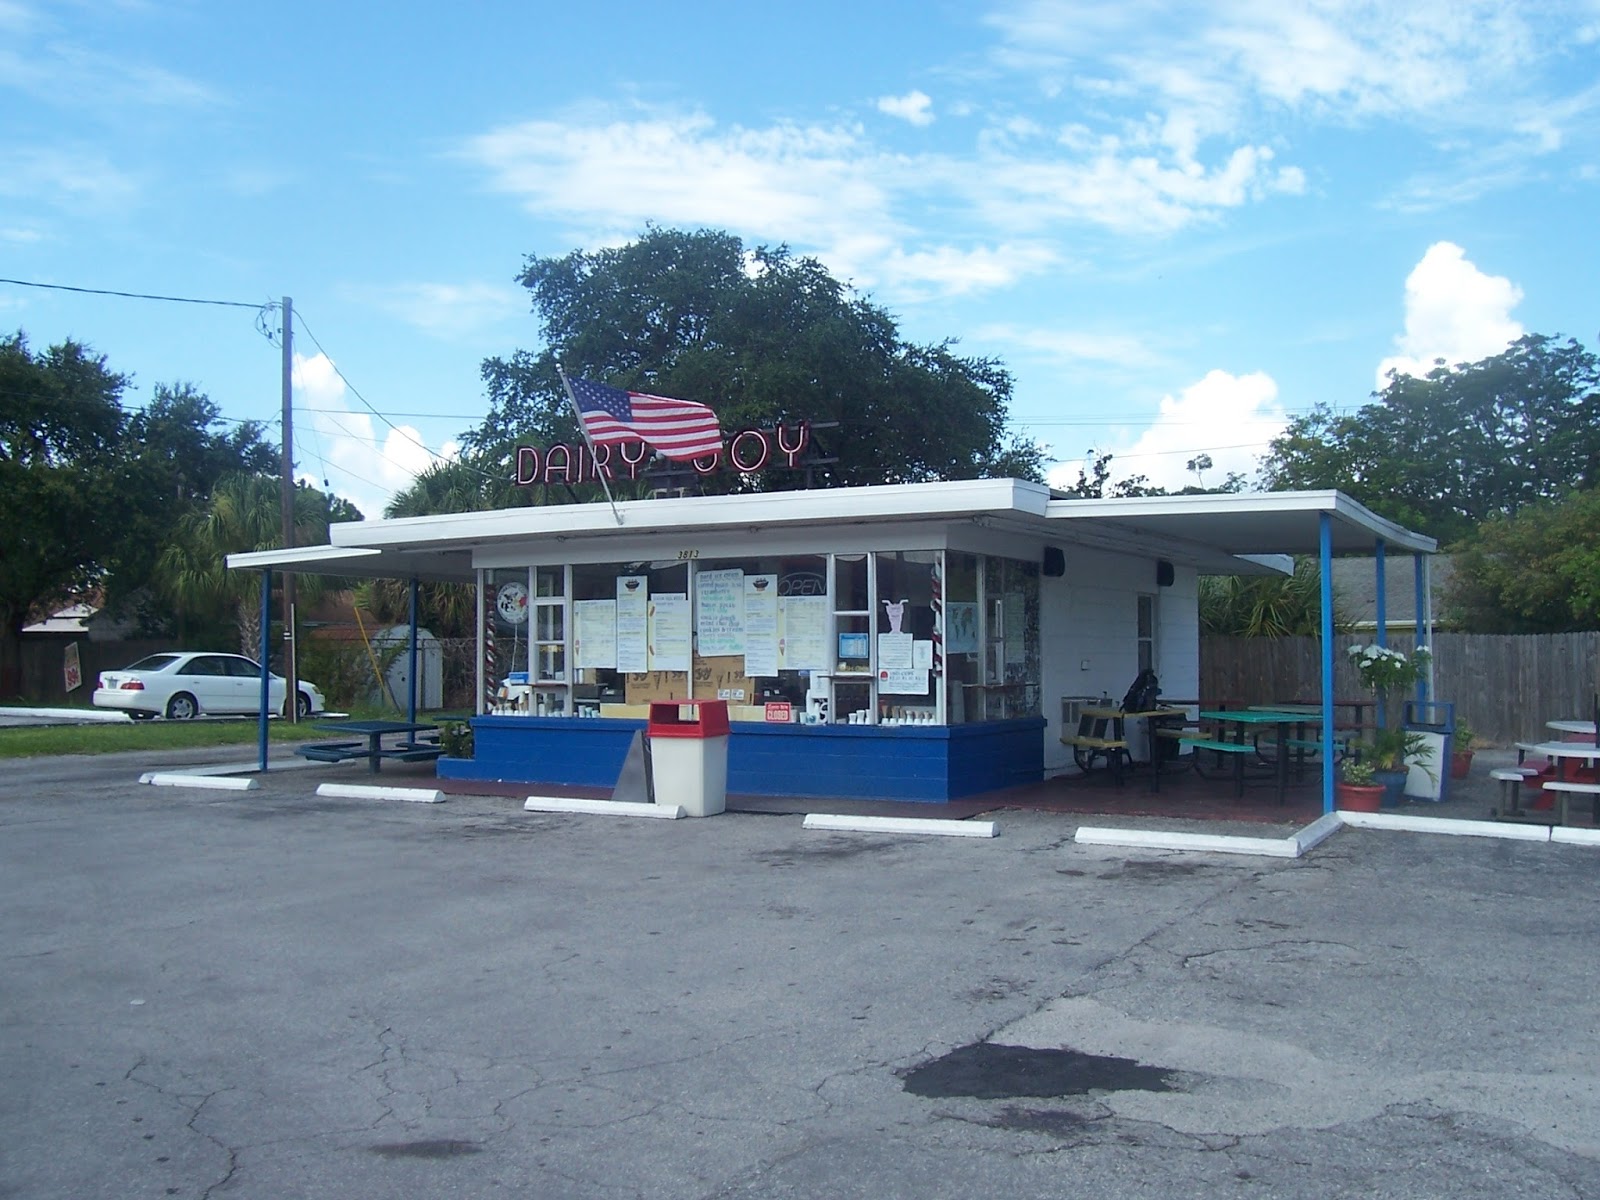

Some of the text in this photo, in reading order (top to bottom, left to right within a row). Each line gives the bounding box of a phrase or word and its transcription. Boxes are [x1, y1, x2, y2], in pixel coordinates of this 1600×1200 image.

[516, 441, 647, 486] DAIRY
[677, 549, 700, 559] 3813
[778, 579, 826, 596] OPEN
[767, 710, 789, 721] CLOSED
